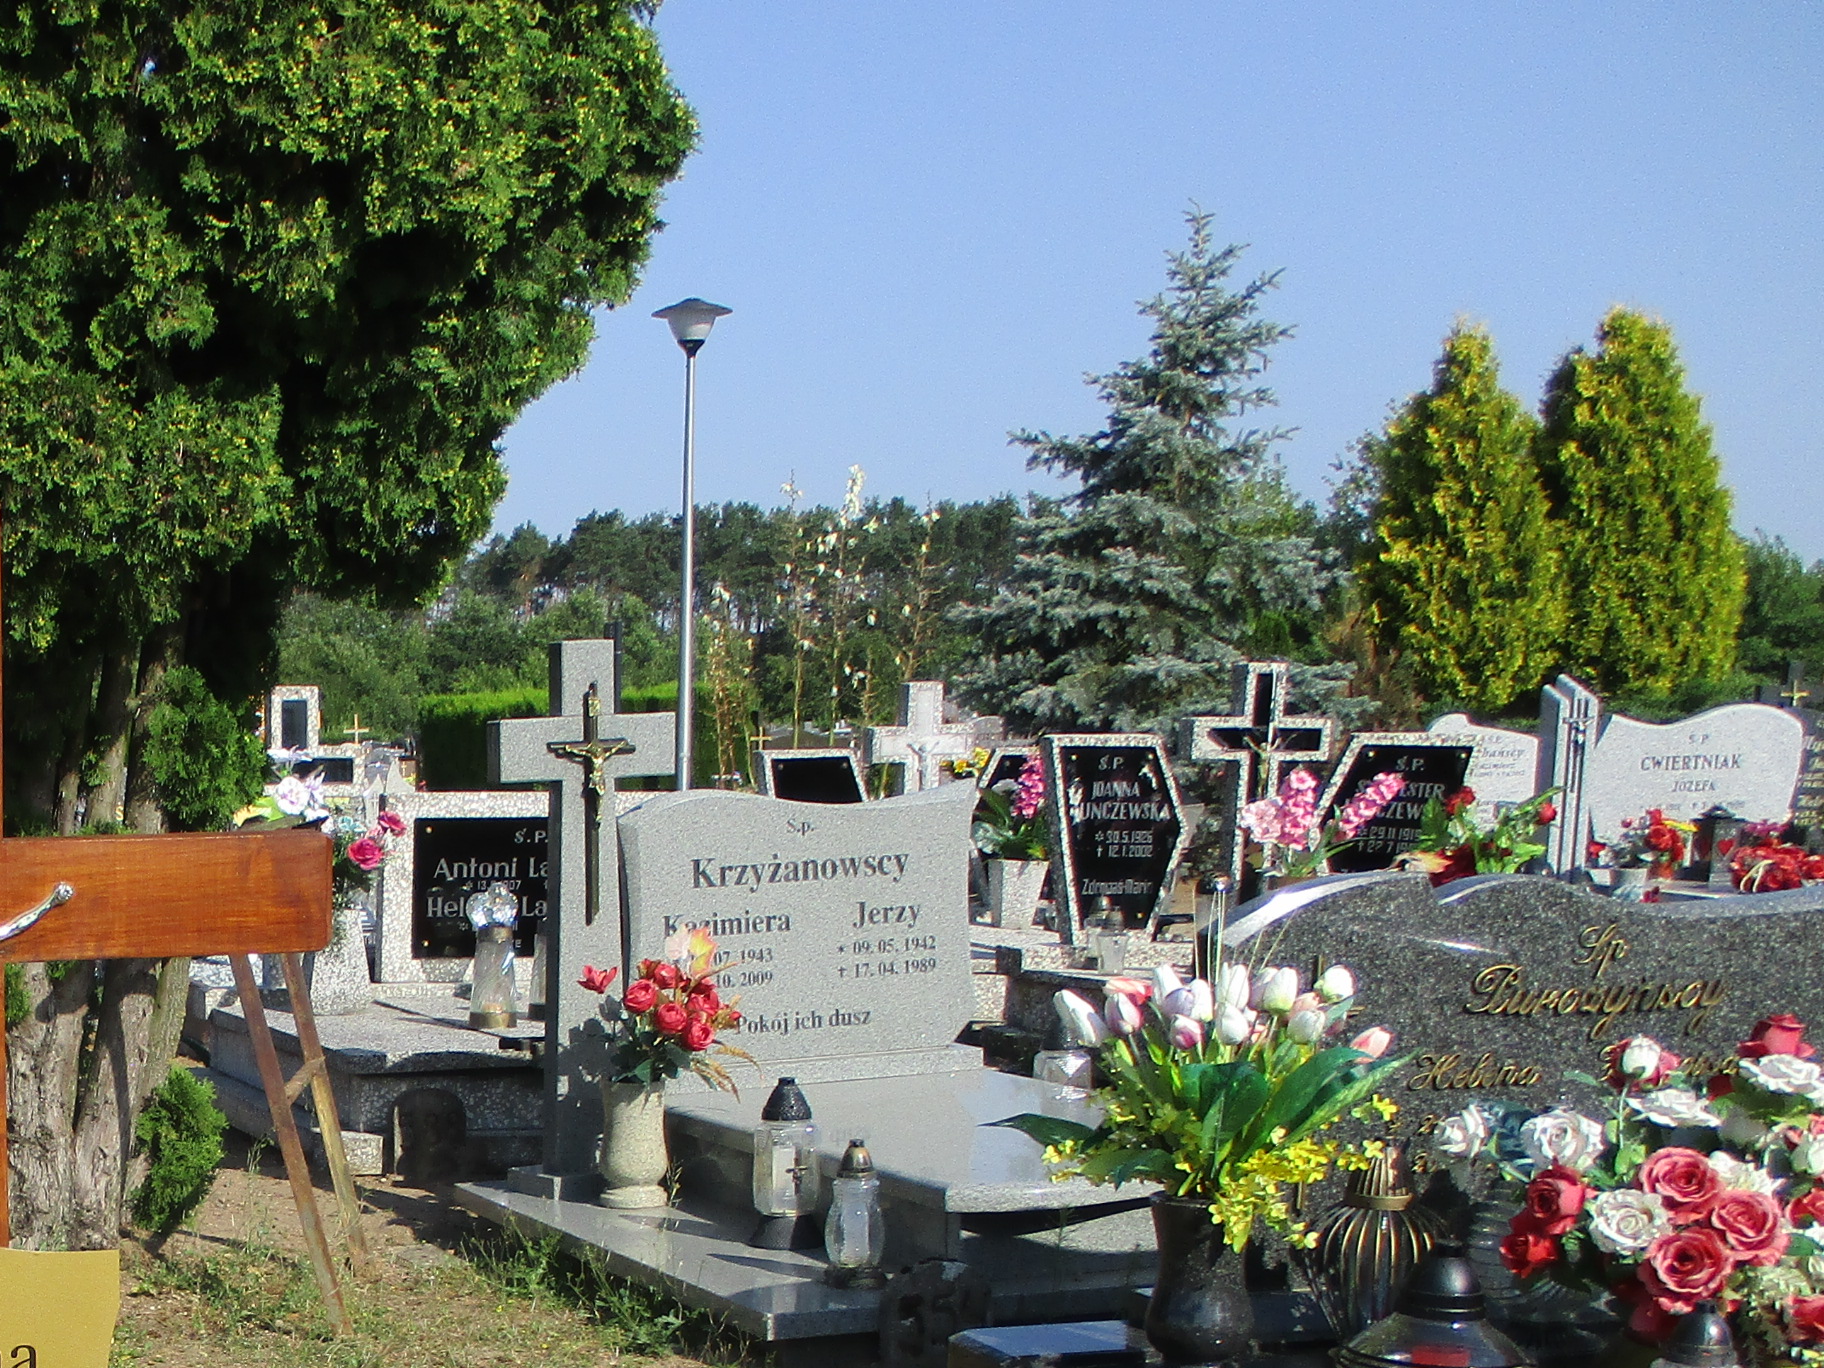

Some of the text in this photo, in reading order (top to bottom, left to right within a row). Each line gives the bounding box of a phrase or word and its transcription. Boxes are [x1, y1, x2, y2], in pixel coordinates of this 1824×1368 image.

[1091, 781, 1140, 799] JOANNA
[433, 857, 518, 879] Antoni
[690, 853, 910, 893] Krzyżanowscy
[663, 910, 791, 938] Kazimiera
[853, 901, 921, 929] Jerzy
[904, 936, 936, 953] 1942
[740, 948, 773, 965] 1943
[904, 958, 936, 975] 1989
[740, 971, 773, 988] 2009
[737, 1008, 871, 1036] Pokój ich dusz
[1407, 1052, 1542, 1091] Helena
